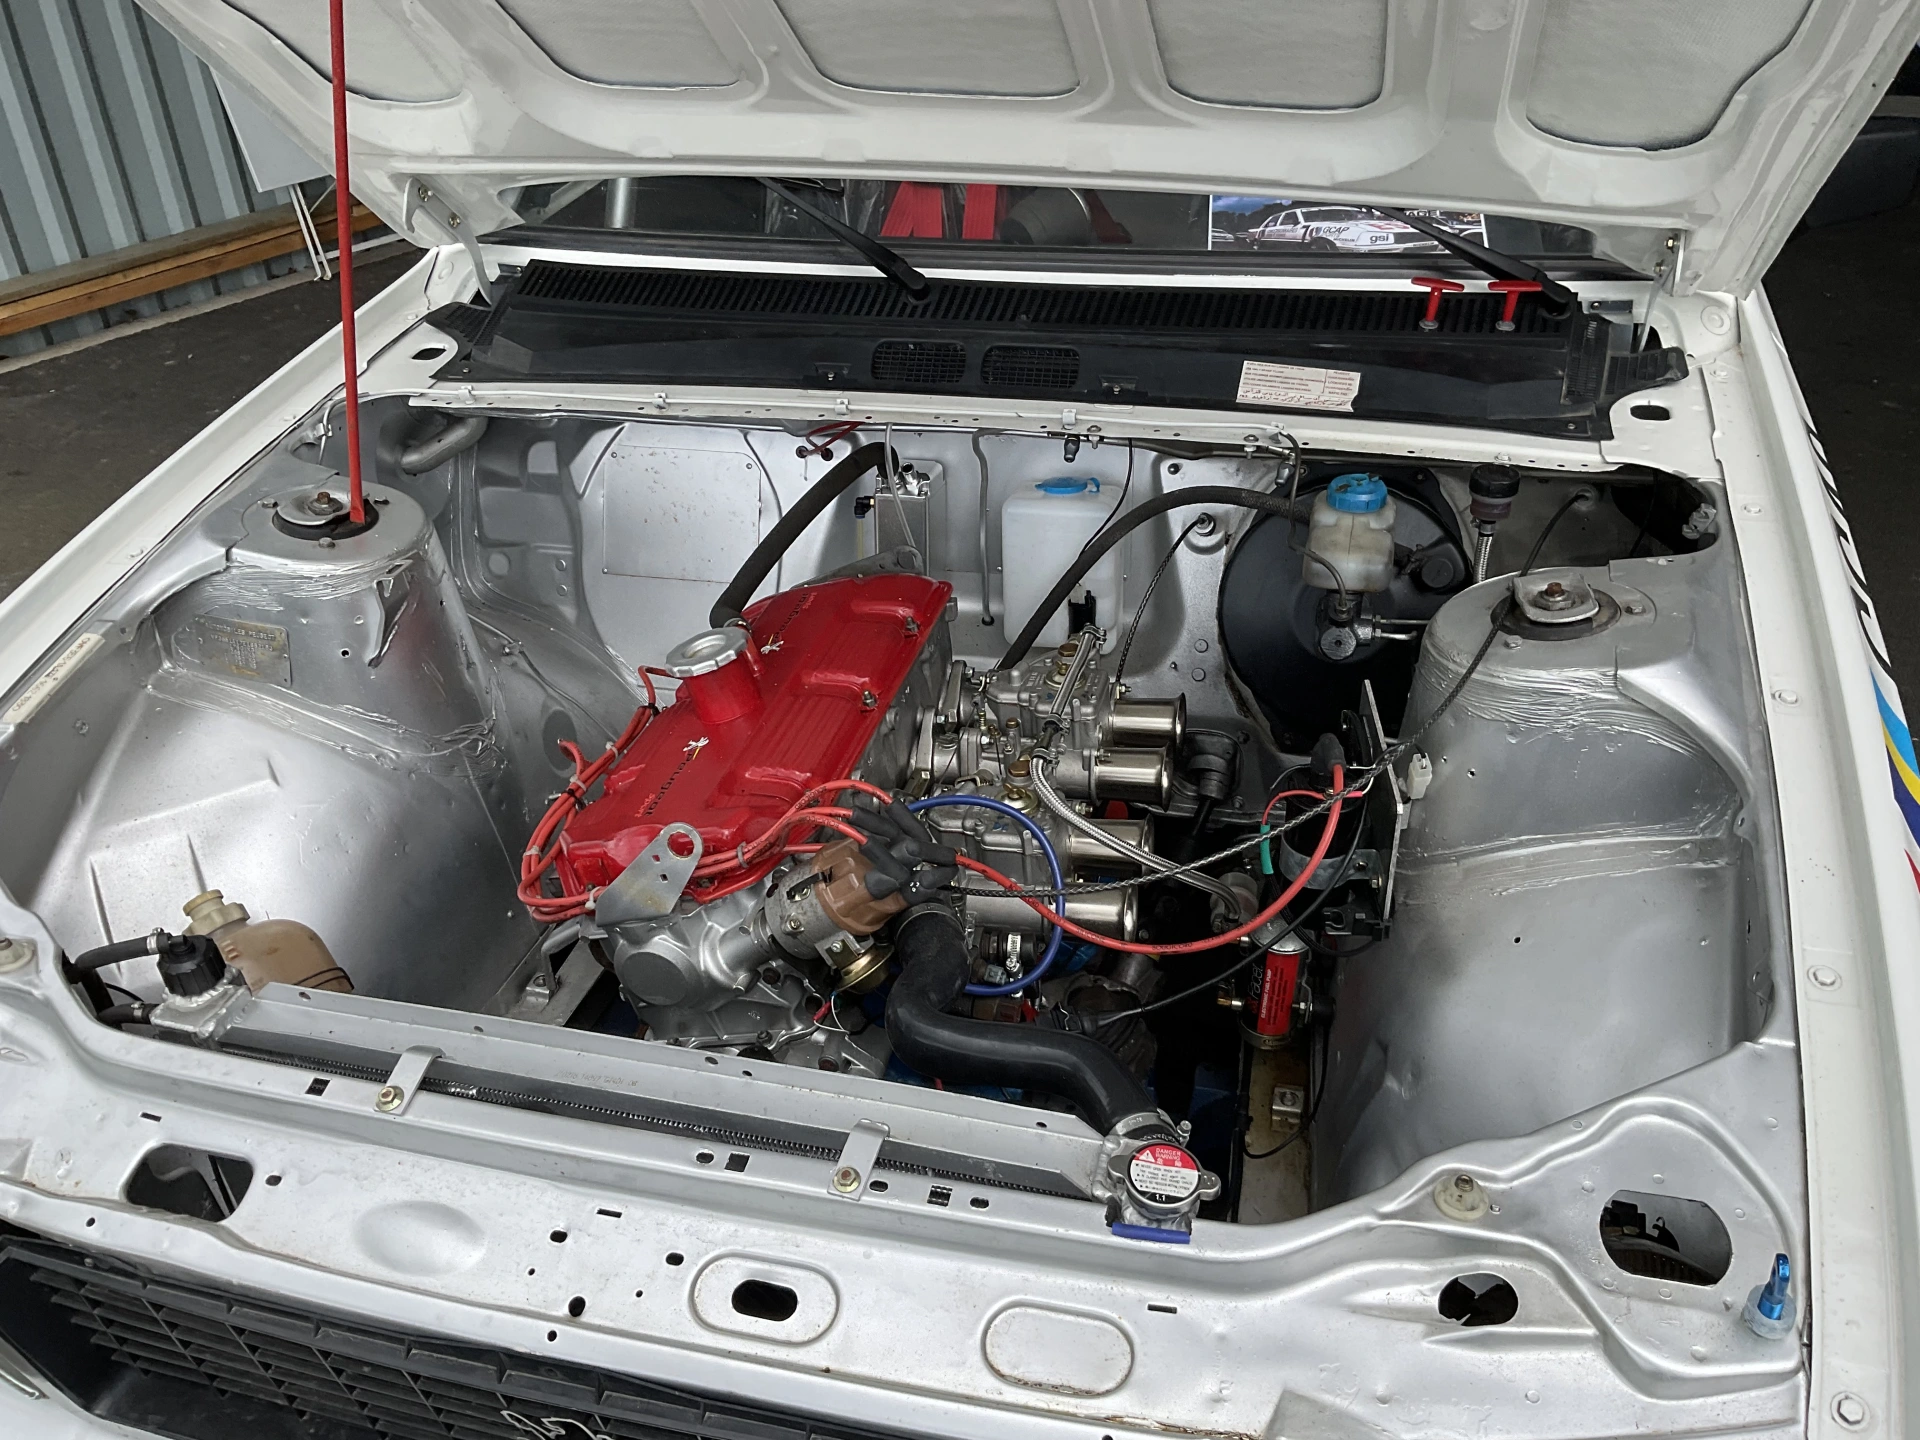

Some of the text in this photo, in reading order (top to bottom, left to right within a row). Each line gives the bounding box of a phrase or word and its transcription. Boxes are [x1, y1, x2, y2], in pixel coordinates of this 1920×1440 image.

[1322, 226, 1351, 234] GCAP
[1369, 233, 1390, 244] gsi
[644, 751, 694, 817] Peugeot
[1156, 1148, 1181, 1156] DANGER
